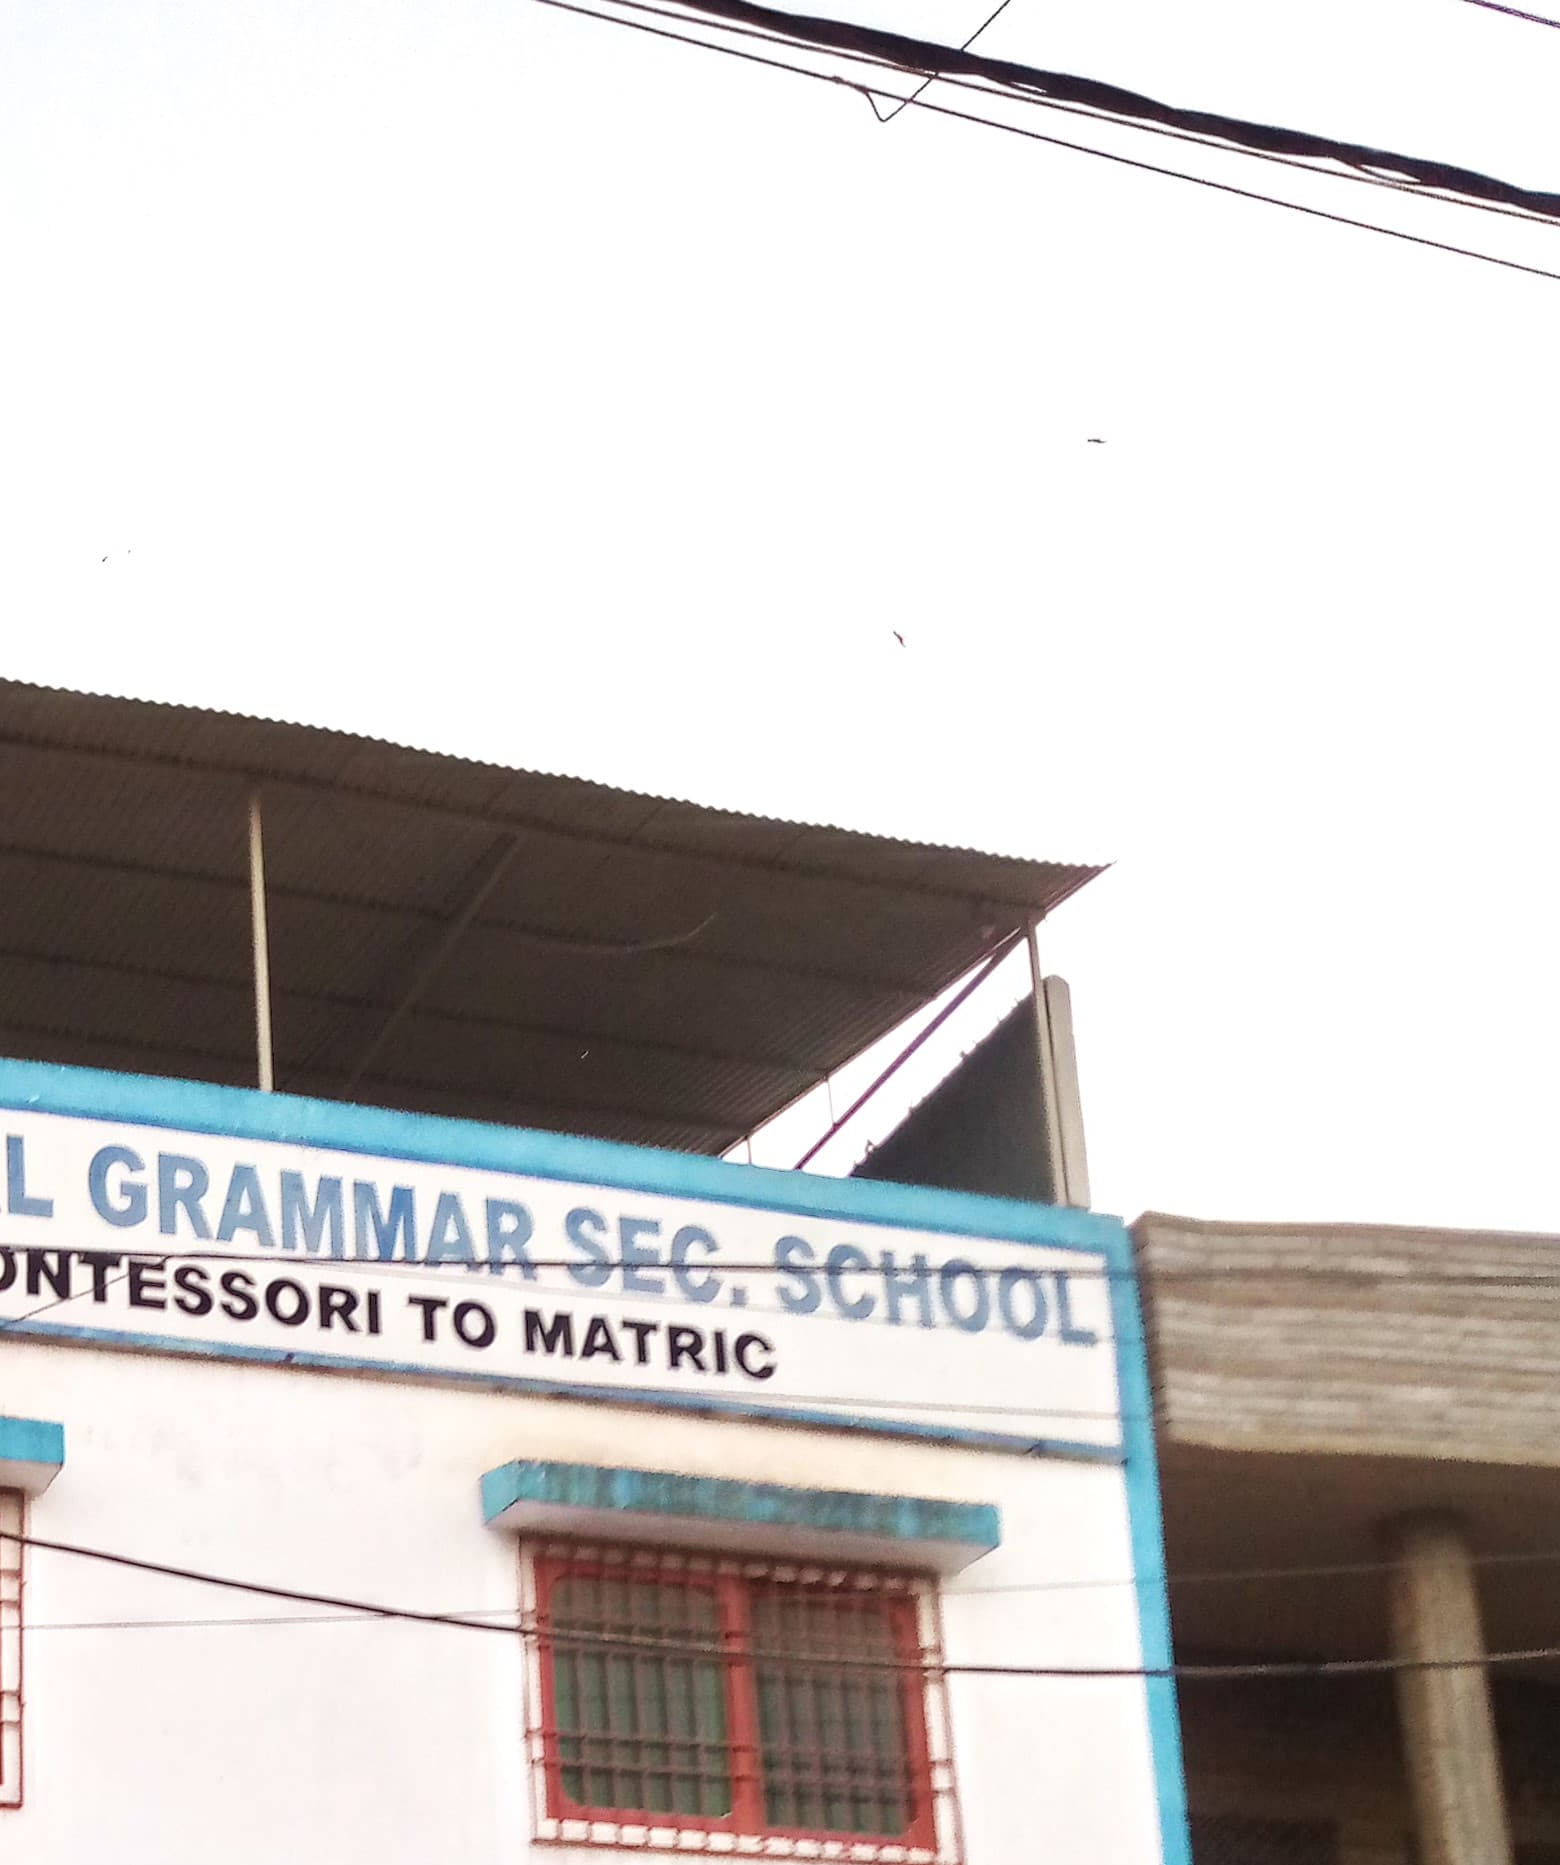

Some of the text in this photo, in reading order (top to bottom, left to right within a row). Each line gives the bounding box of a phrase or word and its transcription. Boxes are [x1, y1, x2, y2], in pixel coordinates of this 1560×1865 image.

[88, 1144, 537, 1279] GRAMMAR
[562, 1206, 749, 1308] SEC.
[774, 1235, 1097, 1347] SCHOOL
[408, 1293, 496, 1349] TO
[524, 1309, 779, 1381] MATRIC
